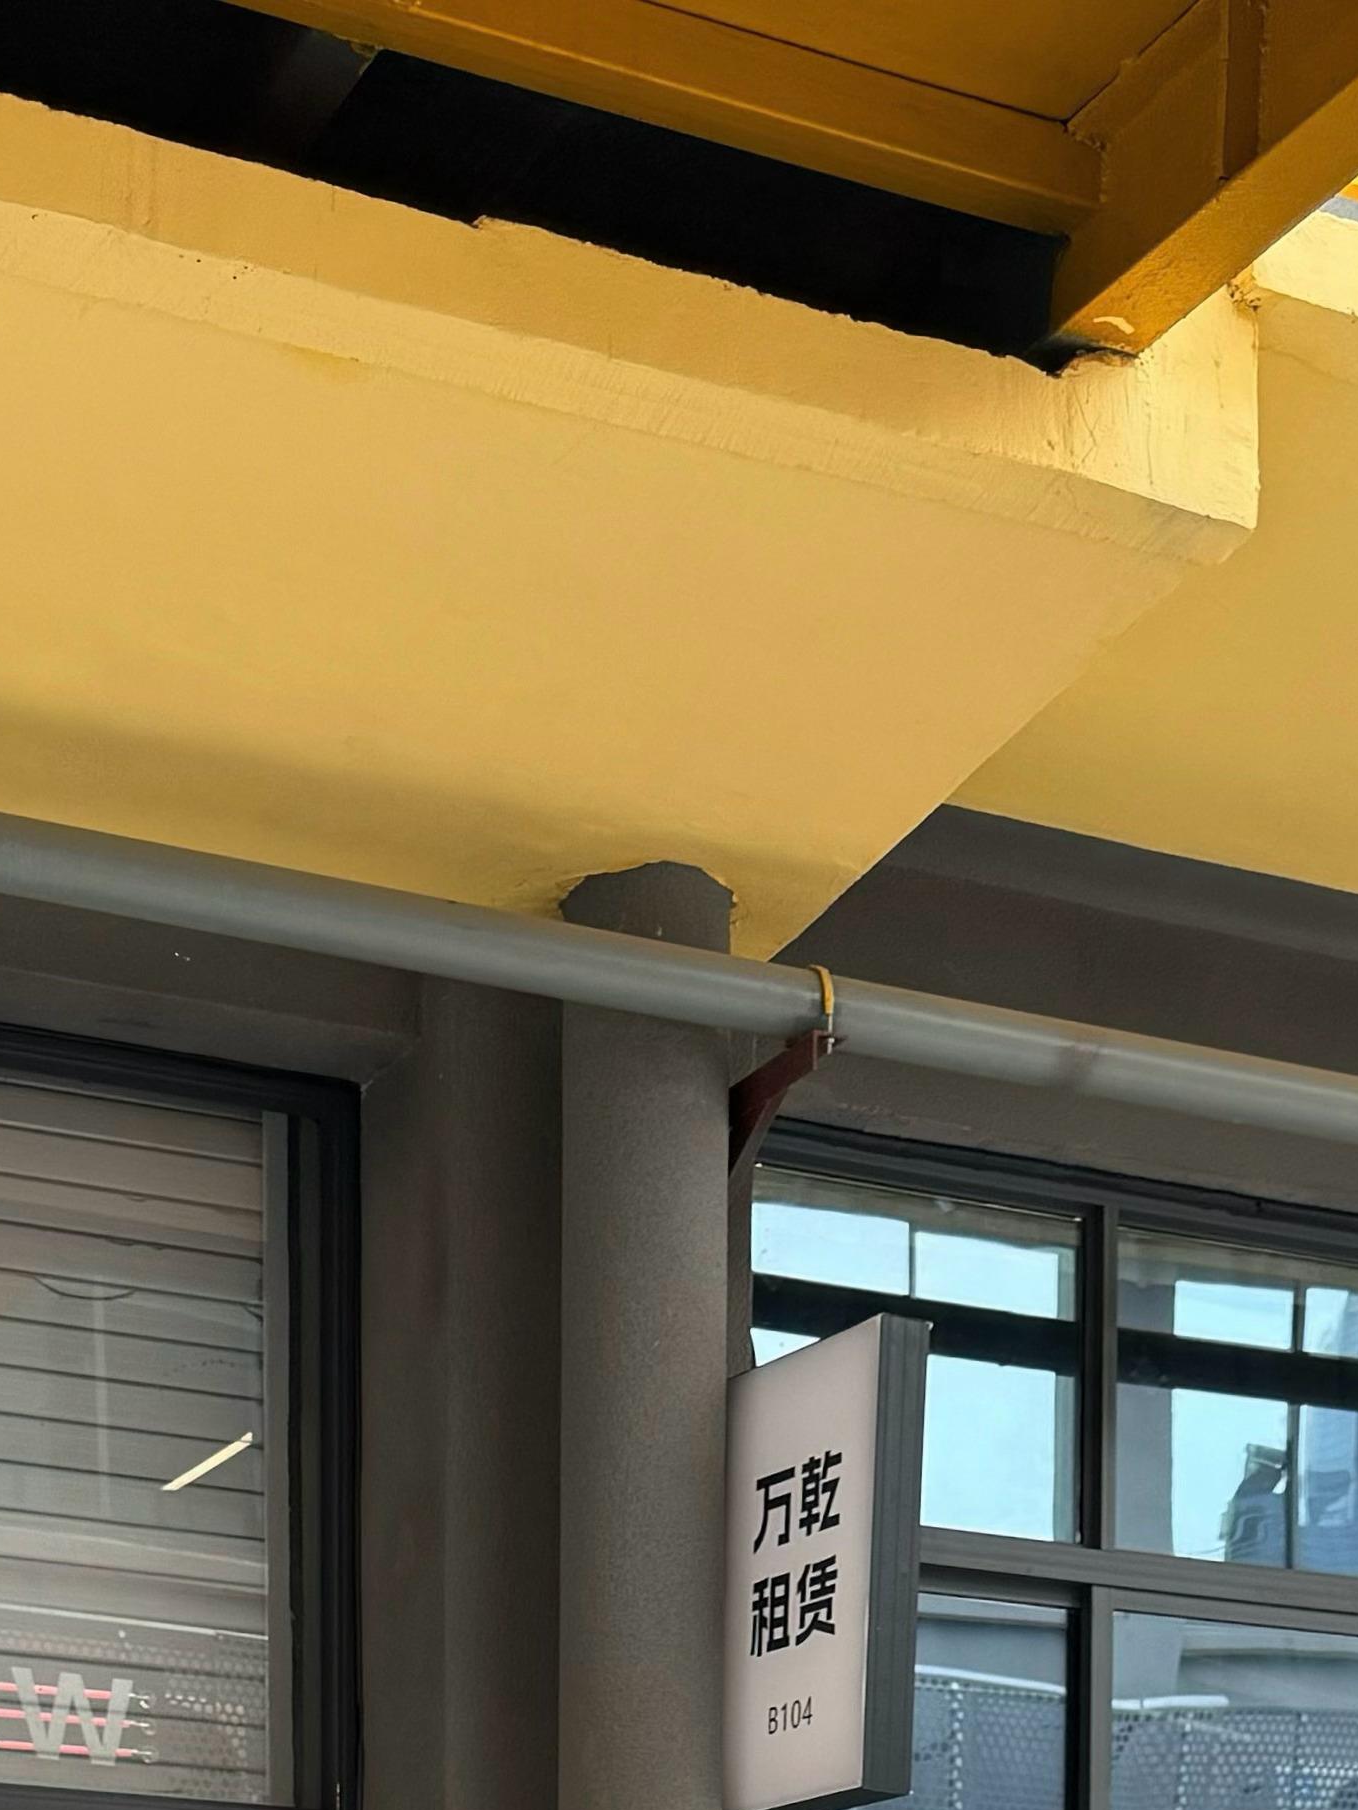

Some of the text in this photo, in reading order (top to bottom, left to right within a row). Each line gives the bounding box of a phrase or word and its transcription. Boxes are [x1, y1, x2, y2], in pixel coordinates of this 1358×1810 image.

[752, 1449, 843, 1555] 万乾
[749, 1553, 838, 1658] 租赁
[766, 1695, 814, 1737] B104
